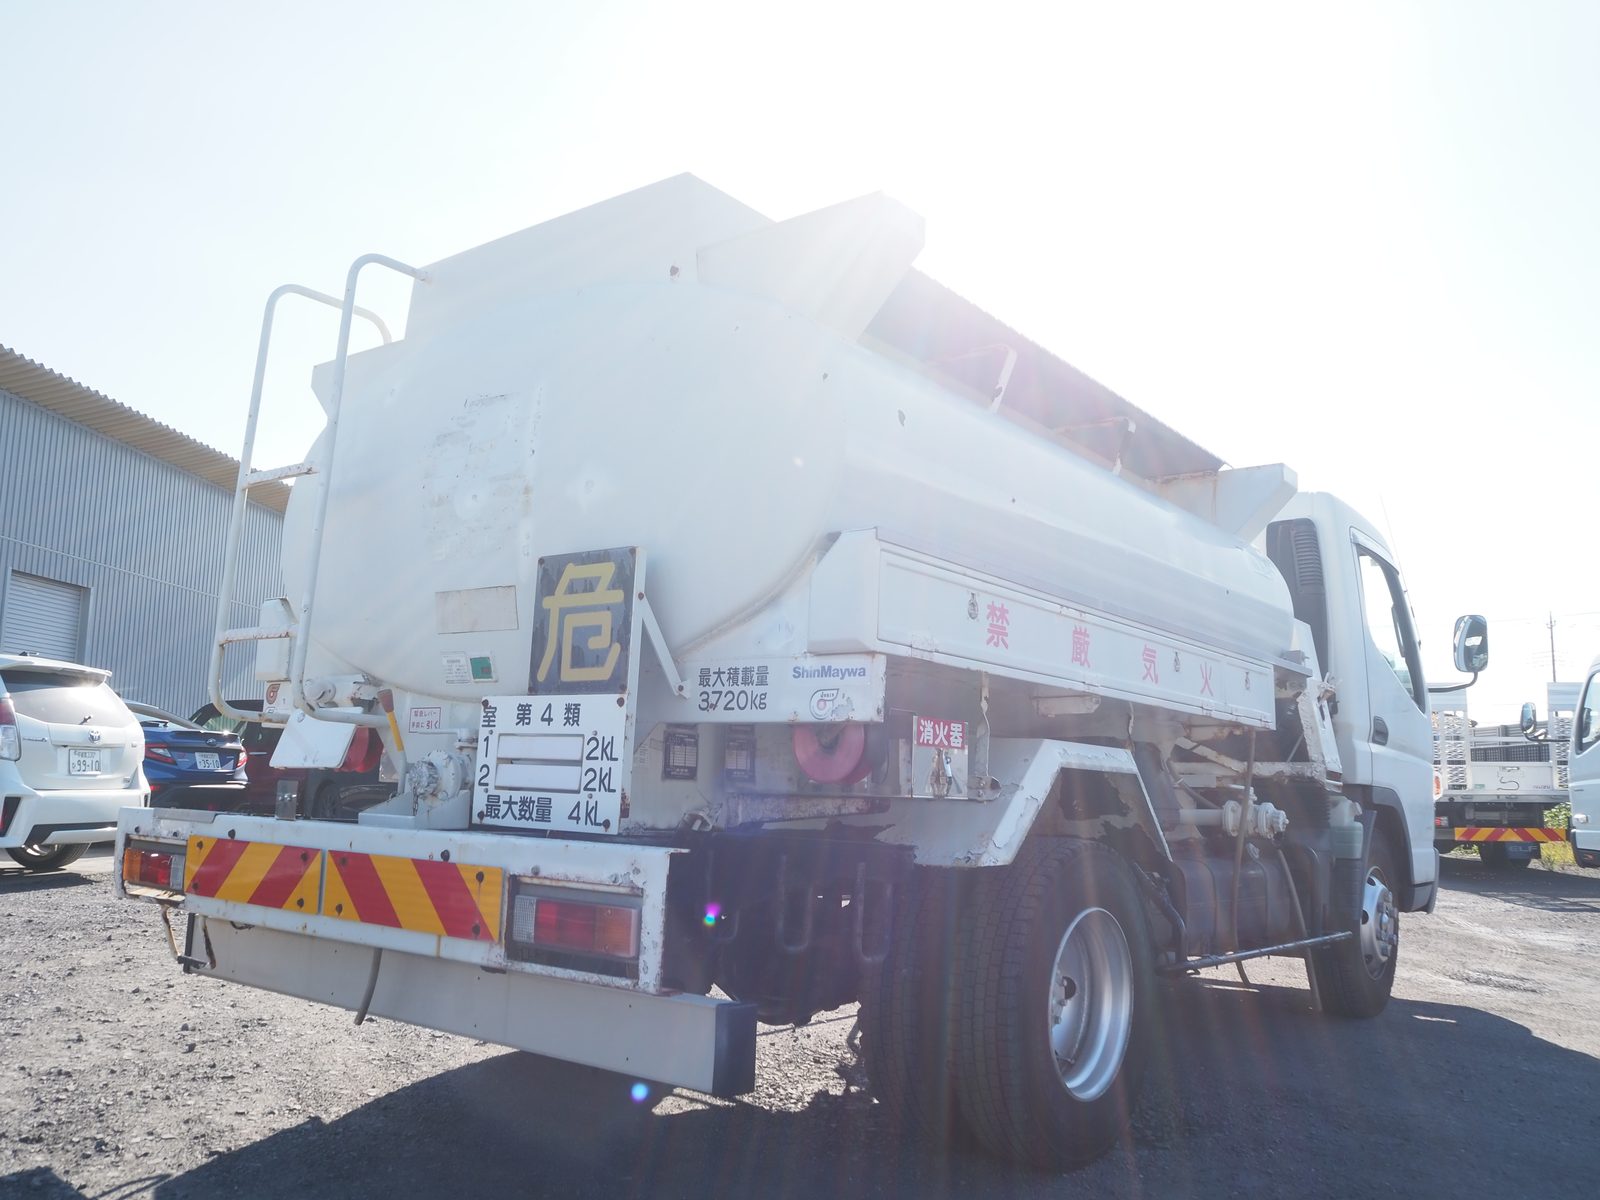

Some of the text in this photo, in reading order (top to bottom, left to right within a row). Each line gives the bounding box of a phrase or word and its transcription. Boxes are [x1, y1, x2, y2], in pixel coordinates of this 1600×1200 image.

[536, 562, 625, 682] 危
[698, 665, 769, 688] 最大積載量
[792, 665, 867, 680] ShinMaywa
[481, 706, 497, 728] 室
[918, 719, 963, 748] 消火器
[483, 735, 490, 759] 1
[478, 764, 490, 787] 2
[484, 794, 553, 823] 最大数量
